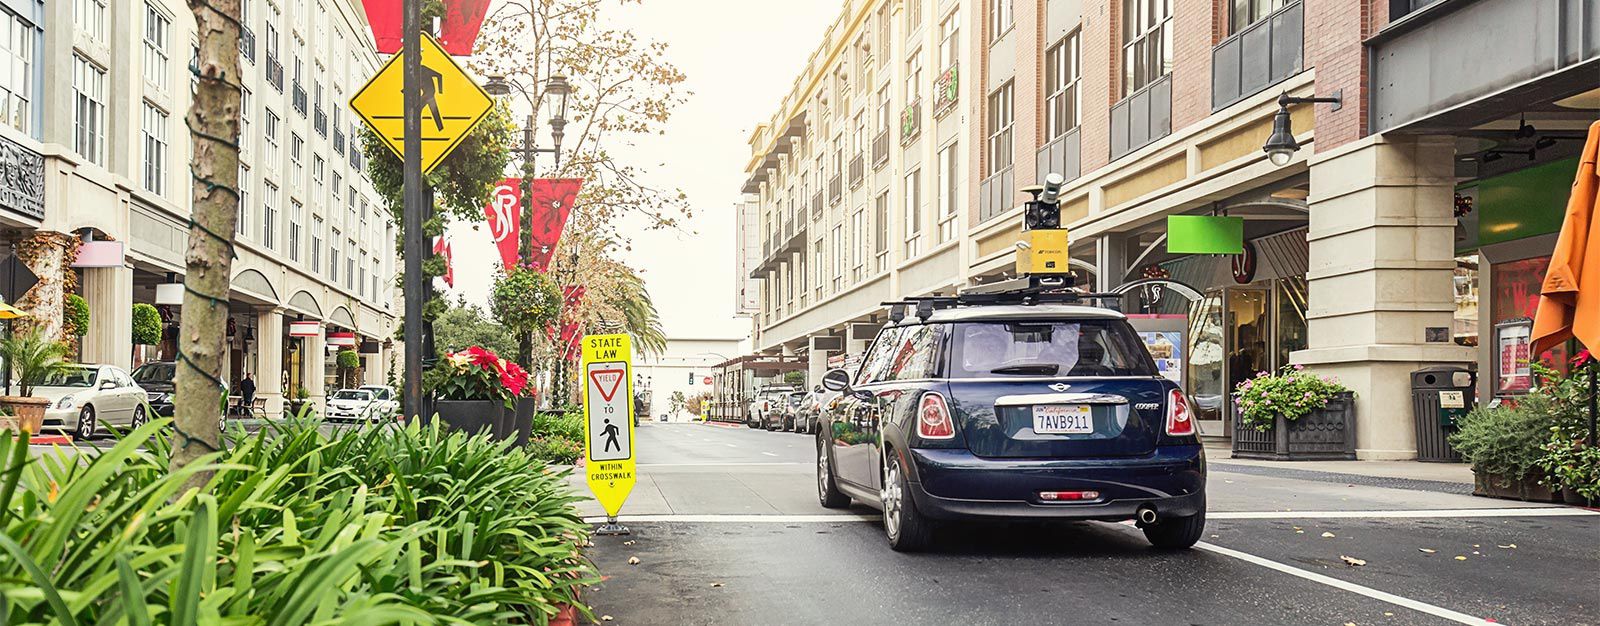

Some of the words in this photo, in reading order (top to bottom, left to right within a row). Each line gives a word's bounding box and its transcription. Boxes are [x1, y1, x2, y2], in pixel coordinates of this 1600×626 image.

[591, 338, 622, 348] STATE
[596, 350, 617, 359] LAW
[1038, 416, 1089, 429] 7AVB911
[591, 473, 632, 481] CROSSWALK
